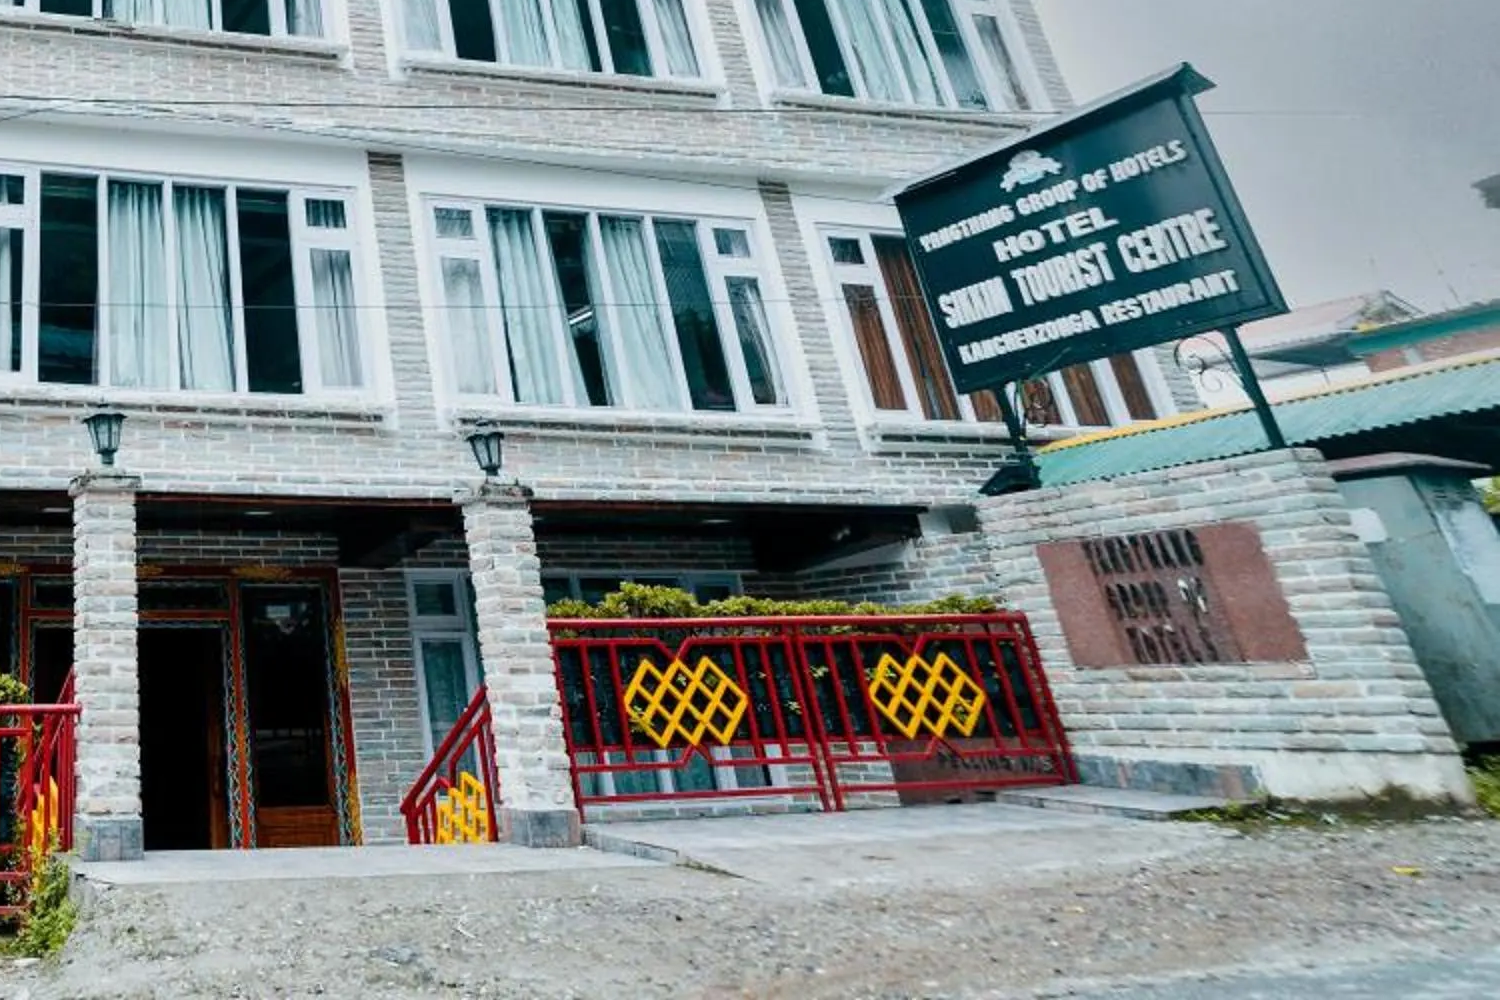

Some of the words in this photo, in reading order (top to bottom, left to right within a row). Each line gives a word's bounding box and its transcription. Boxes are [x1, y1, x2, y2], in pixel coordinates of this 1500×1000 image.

[1016, 179, 1079, 215] GROUP
[1081, 170, 1109, 193] OF
[1109, 140, 1188, 183] HOTELS
[992, 207, 1119, 262] HOTEL
[938, 276, 1013, 329] SIKKIM
[1010, 242, 1115, 306] TOURIST
[1117, 208, 1229, 273] CENTRE
[1099, 270, 1240, 325] RESTAURANT
[1105, 581, 1172, 621] GROUP
[1126, 624, 1220, 665] HOTELS
